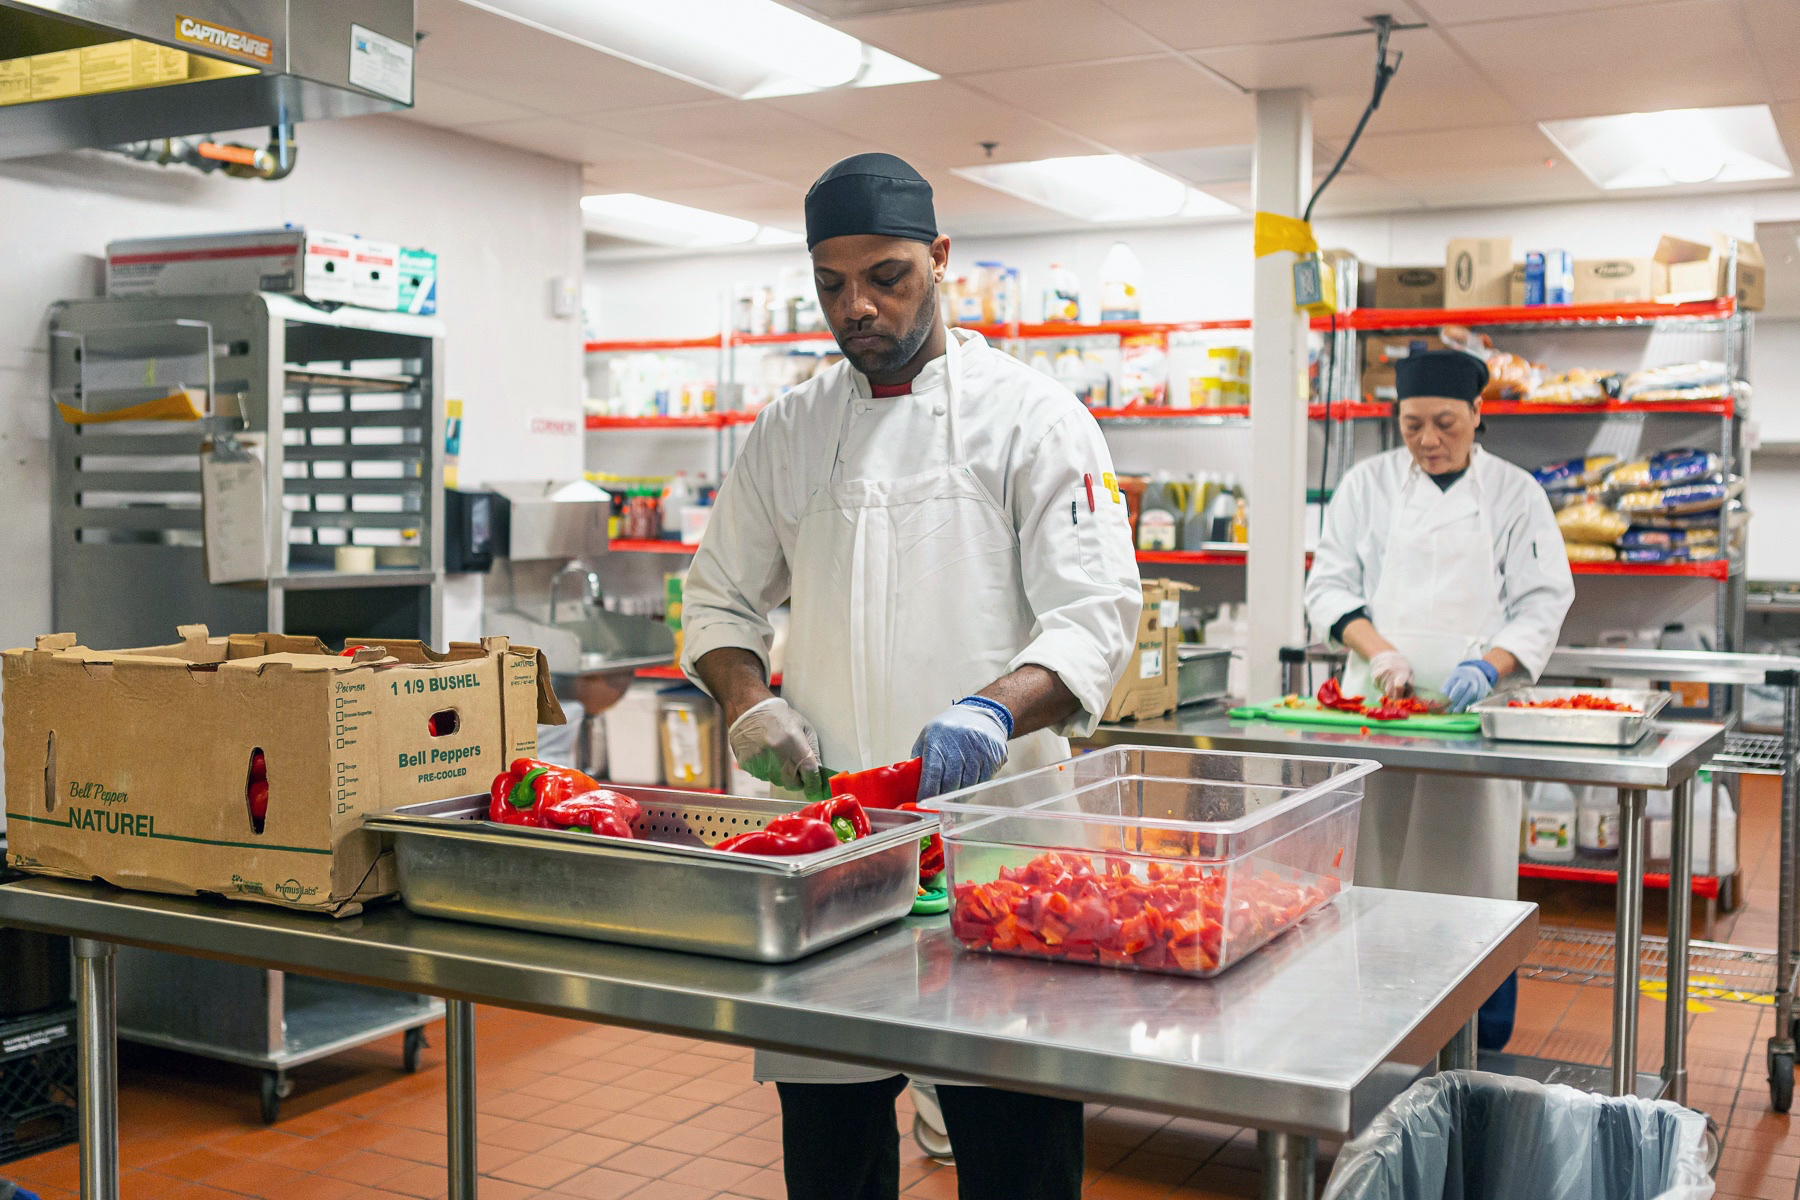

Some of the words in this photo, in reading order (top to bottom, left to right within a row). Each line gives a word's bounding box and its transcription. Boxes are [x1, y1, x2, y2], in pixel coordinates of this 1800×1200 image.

[181, 18, 270, 57] CAPTIVEAIRE
[391, 681, 398, 696] 1
[404, 679, 425, 695] 1/9
[429, 673, 480, 692] BUSHEL
[399, 750, 426, 768] Bell
[431, 745, 481, 764] Peppers
[418, 767, 467, 783] PRE-COOLED
[69, 781, 93, 799] Bell
[93, 783, 129, 807] Pepper
[69, 806, 155, 838] NATUREL
